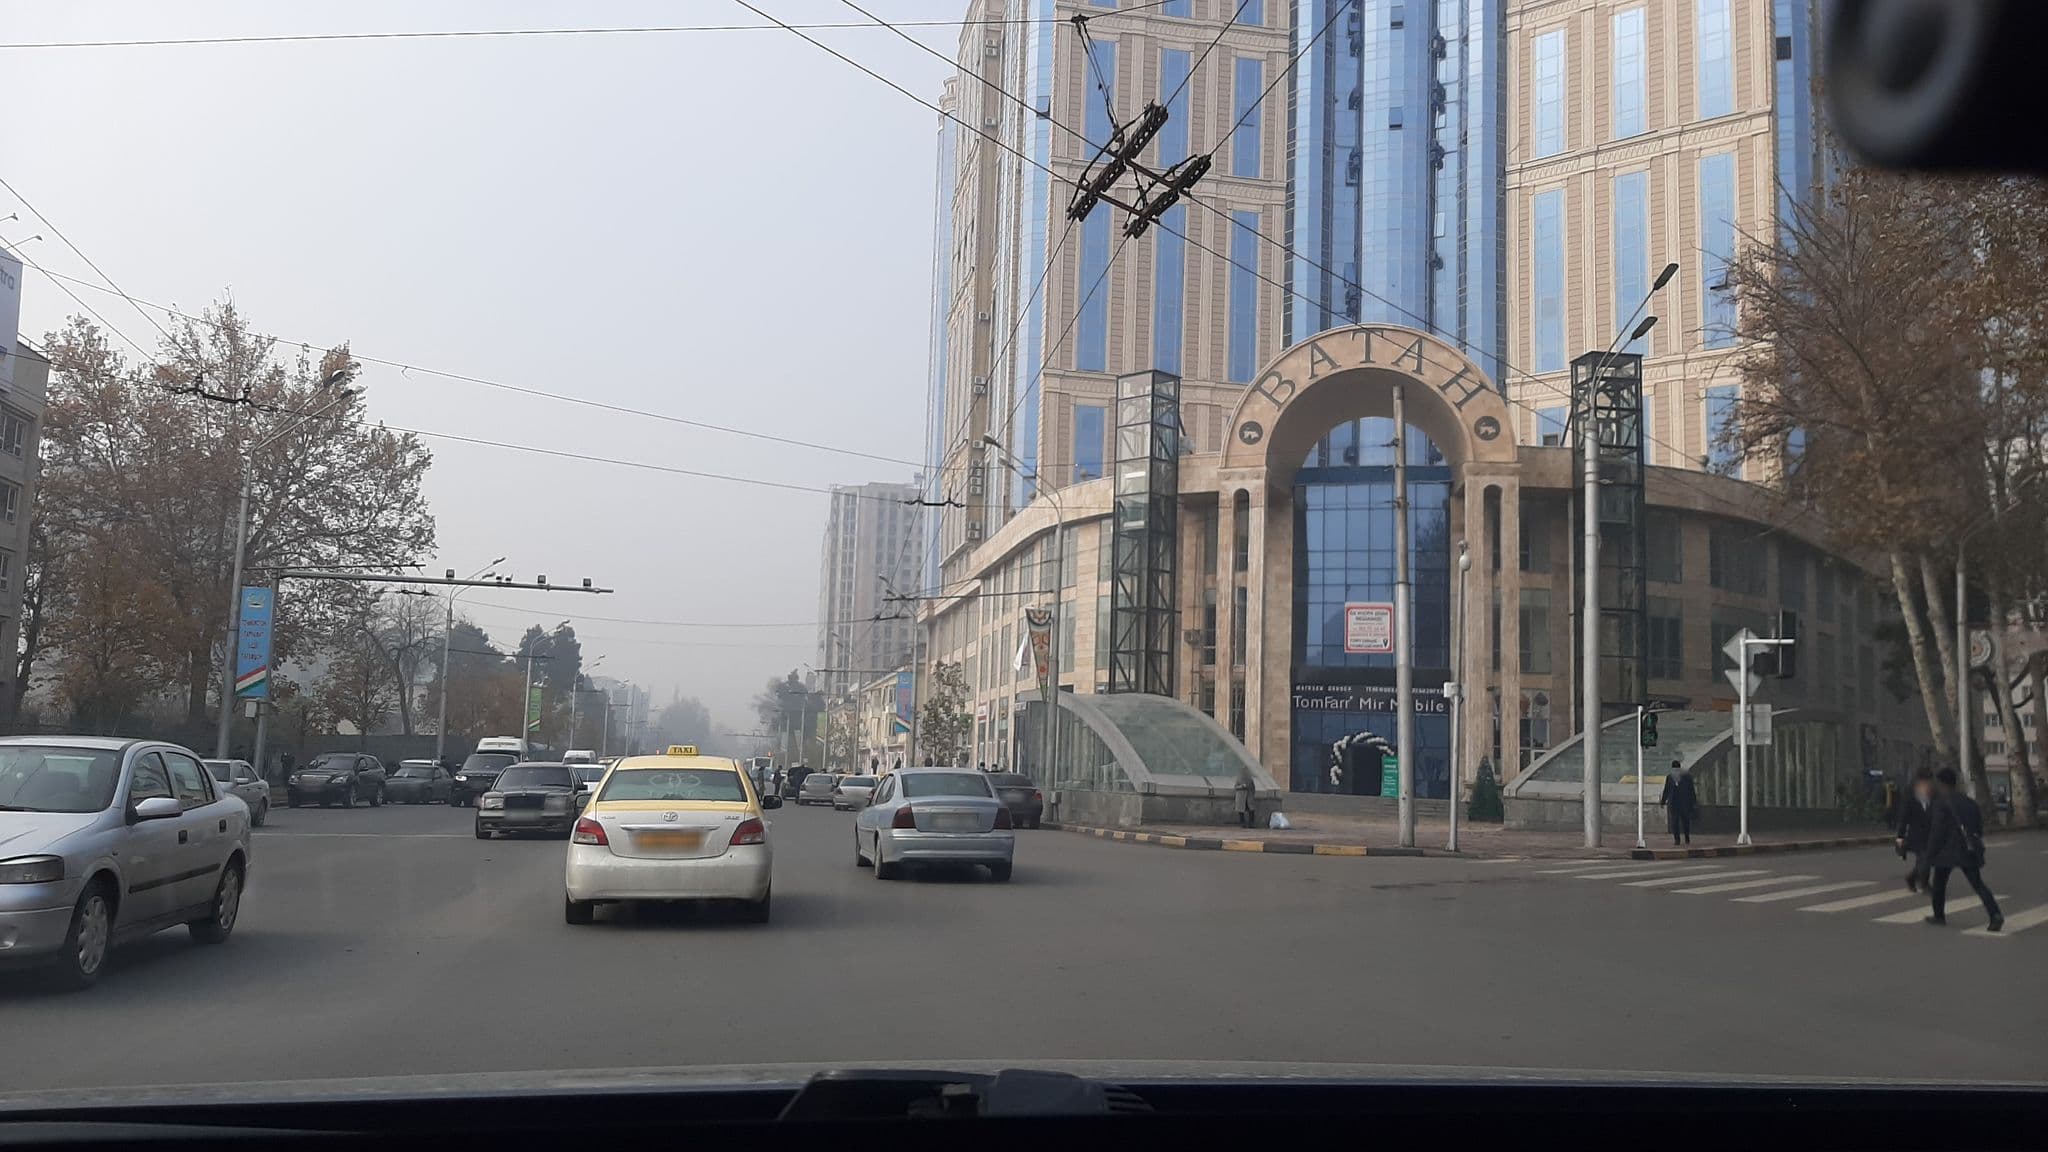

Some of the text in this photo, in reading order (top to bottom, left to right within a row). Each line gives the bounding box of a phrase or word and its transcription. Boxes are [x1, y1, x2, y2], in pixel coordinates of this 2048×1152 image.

[1254, 329, 1488, 413] ВАТАН
[1359, 697, 1444, 713] Mir Mbile
[673, 746, 693, 754] TAXI
